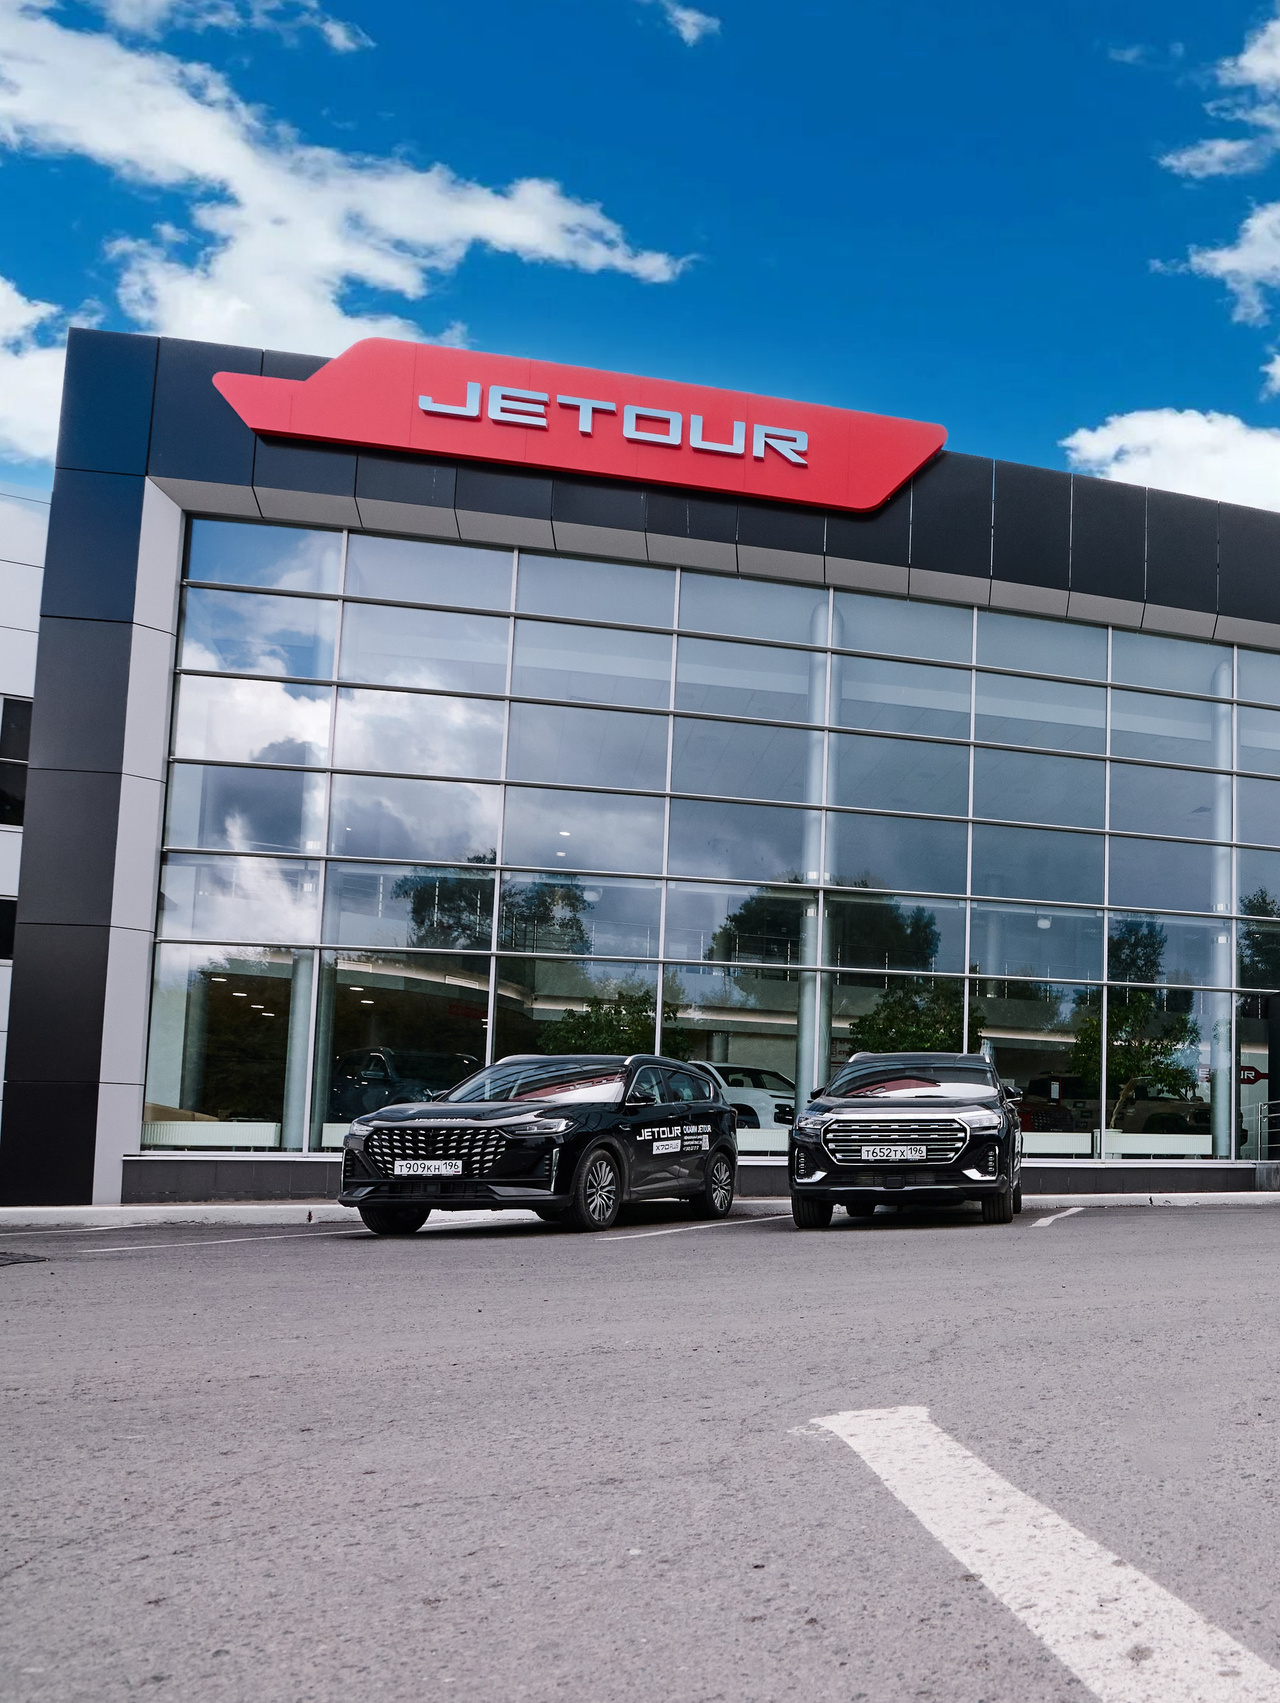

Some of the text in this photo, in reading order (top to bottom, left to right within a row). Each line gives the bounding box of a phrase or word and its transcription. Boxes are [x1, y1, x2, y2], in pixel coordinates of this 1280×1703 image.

[418, 382, 809, 467] JETOUR
[636, 1126, 681, 1140] JETOUR
[865, 1147, 924, 1158] Т652ТХ 196
[398, 1161, 459, 1173] Т909КН 196
